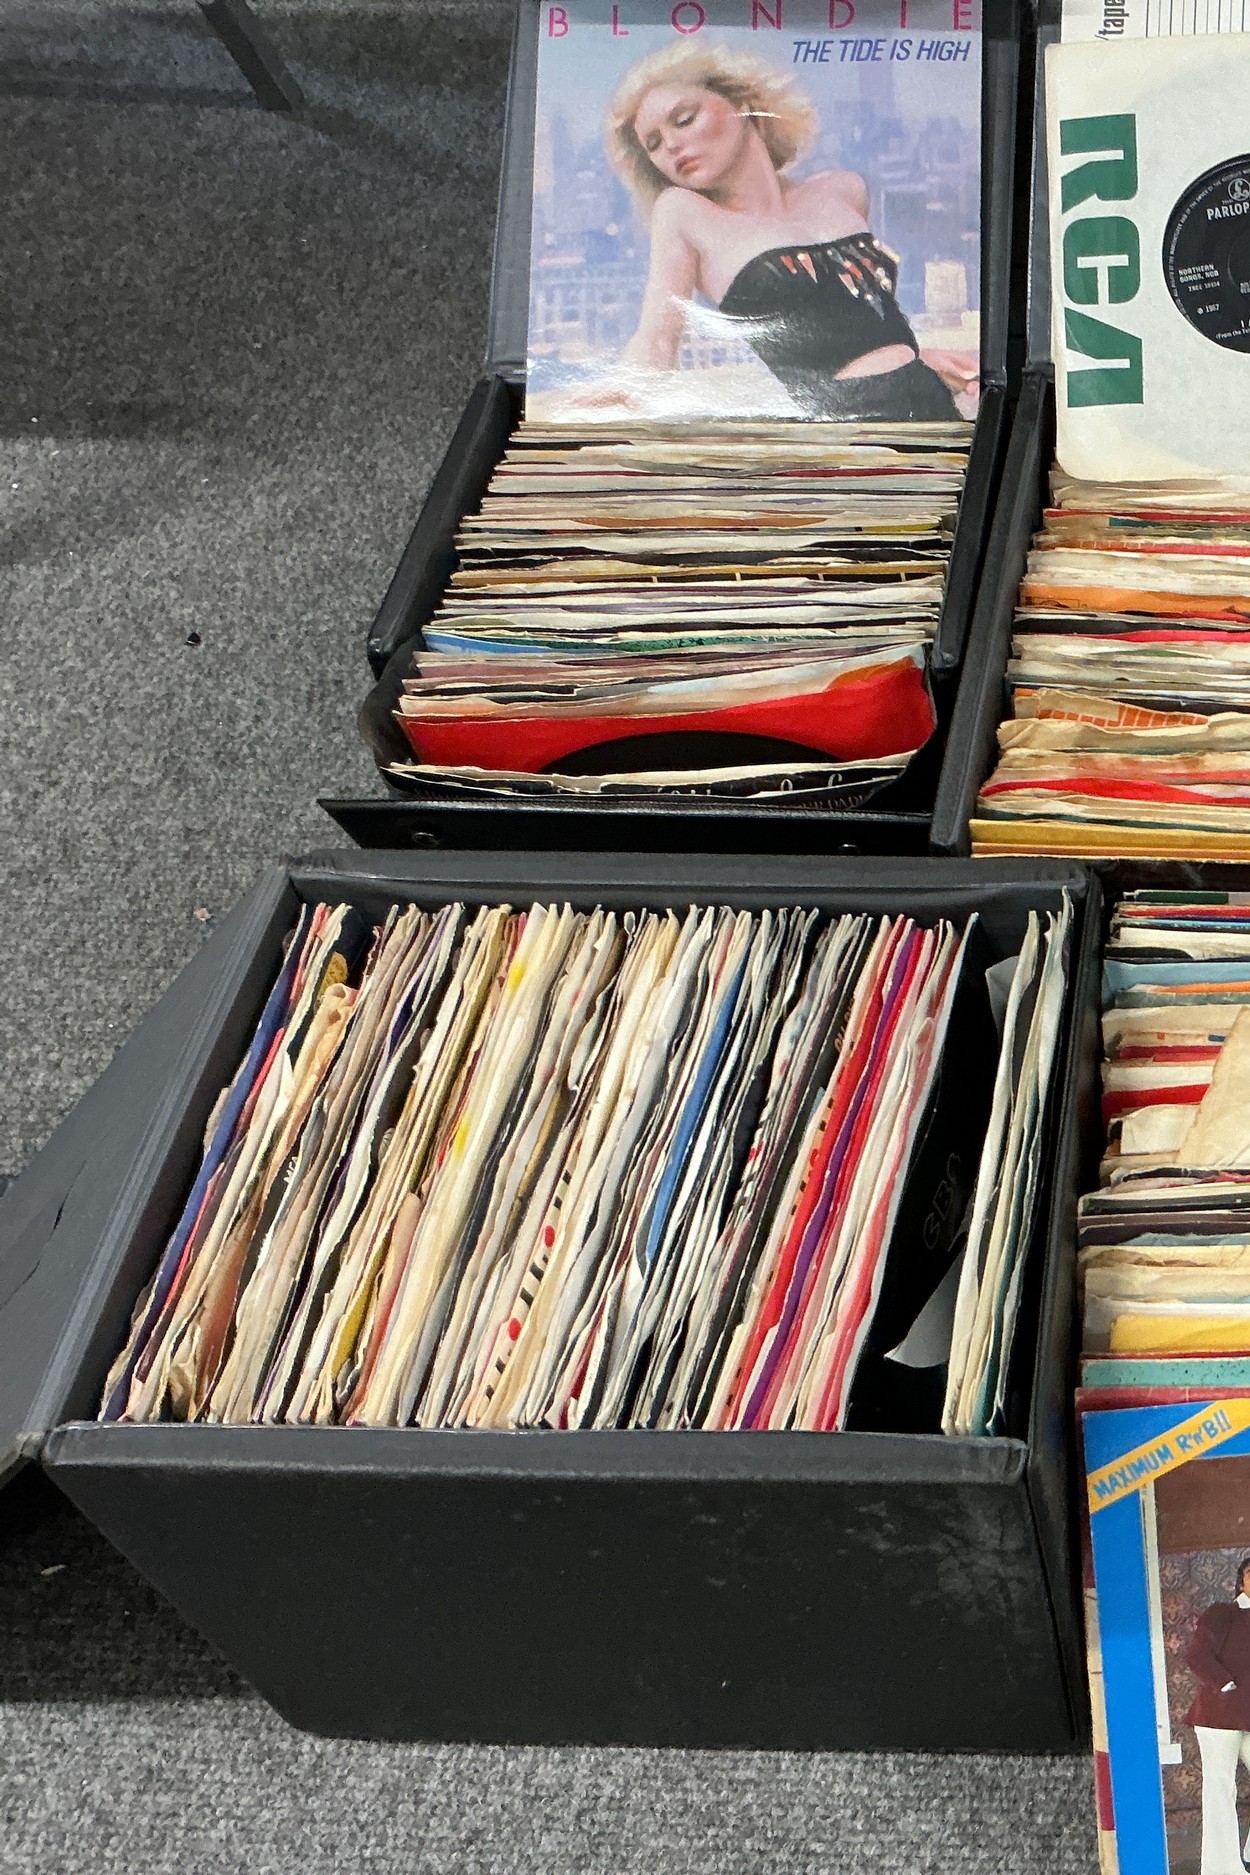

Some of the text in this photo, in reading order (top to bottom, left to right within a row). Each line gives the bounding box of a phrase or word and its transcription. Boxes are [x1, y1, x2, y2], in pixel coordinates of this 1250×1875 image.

[548, 0, 977, 37] BLONDIE
[793, 39, 971, 63] THE TIDE IS HIGH
[1060, 113, 1144, 408] RCA
[1178, 263, 1215, 276] NORTHERN
[1240, 319, 1245, 328] I
[1092, 1443, 1175, 1499] MAXIMUM
